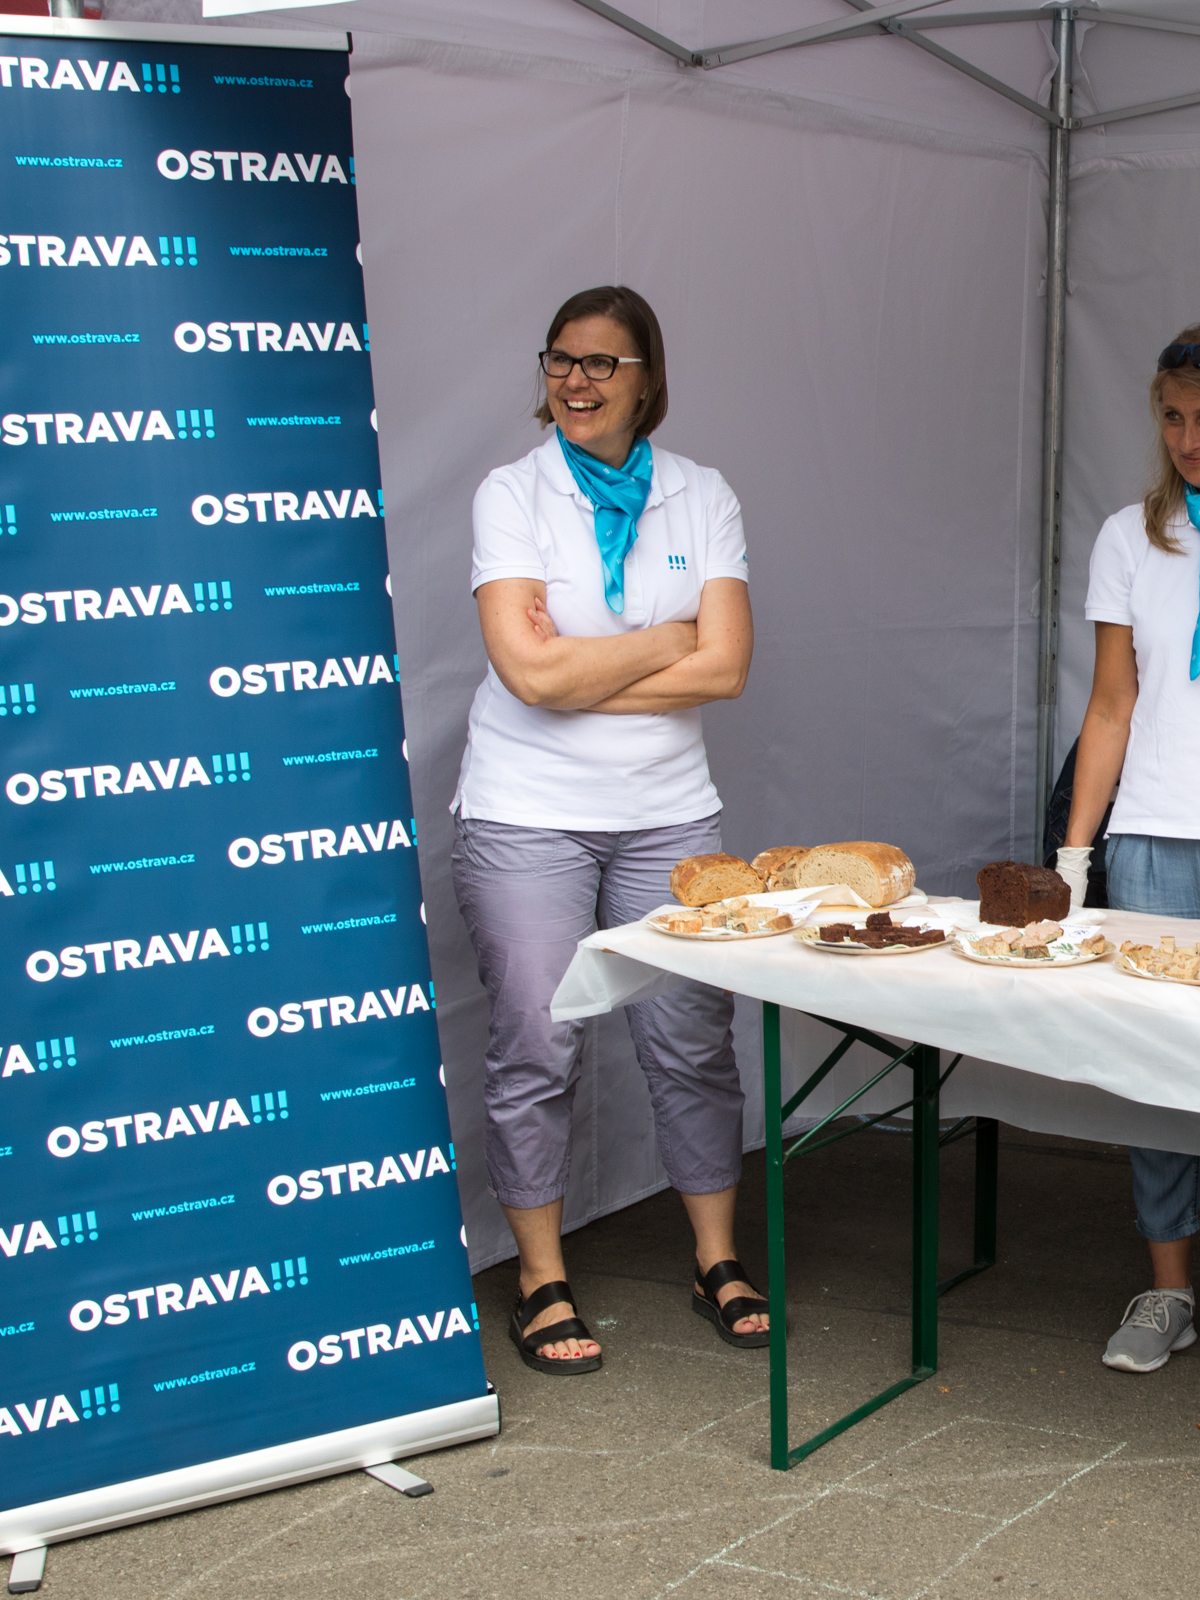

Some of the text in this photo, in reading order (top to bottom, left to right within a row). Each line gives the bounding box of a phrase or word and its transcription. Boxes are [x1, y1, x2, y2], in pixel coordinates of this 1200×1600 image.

[213, 73, 314, 89] www.ostrava.cz
[15, 154, 123, 169] www.ostrava.cz
[229, 245, 328, 258] www.ostrava.cz
[32, 332, 141, 345] www.ostrava.cz
[0, 409, 215, 446] STRAVA!!!
[246, 412, 342, 427] www.ostrava.cz
[50, 506, 159, 523] www.ostrava.cz
[264, 581, 361, 597] www.ostrava.cz
[69, 680, 177, 700] www.ostrava.cz
[282, 747, 379, 767] www.ostrava.cz
[6, 751, 251, 805] OSTRAVA!!!
[89, 852, 196, 875] www.ostrava.cz
[301, 912, 397, 935] www.ostrava.cz
[26, 921, 270, 982] OSTRAVA!!!
[109, 1024, 215, 1049] www.ostrava.cz
[319, 1077, 417, 1102] www.ostrava.cz
[48, 1090, 289, 1157] OSTRAVA!!!
[131, 1193, 236, 1222] www.ostrava.cz
[338, 1239, 436, 1267] www.ostrava.cz
[70, 1256, 309, 1331] OSTRAVA!!!
[153, 1361, 256, 1393] www.ostrava.cz
